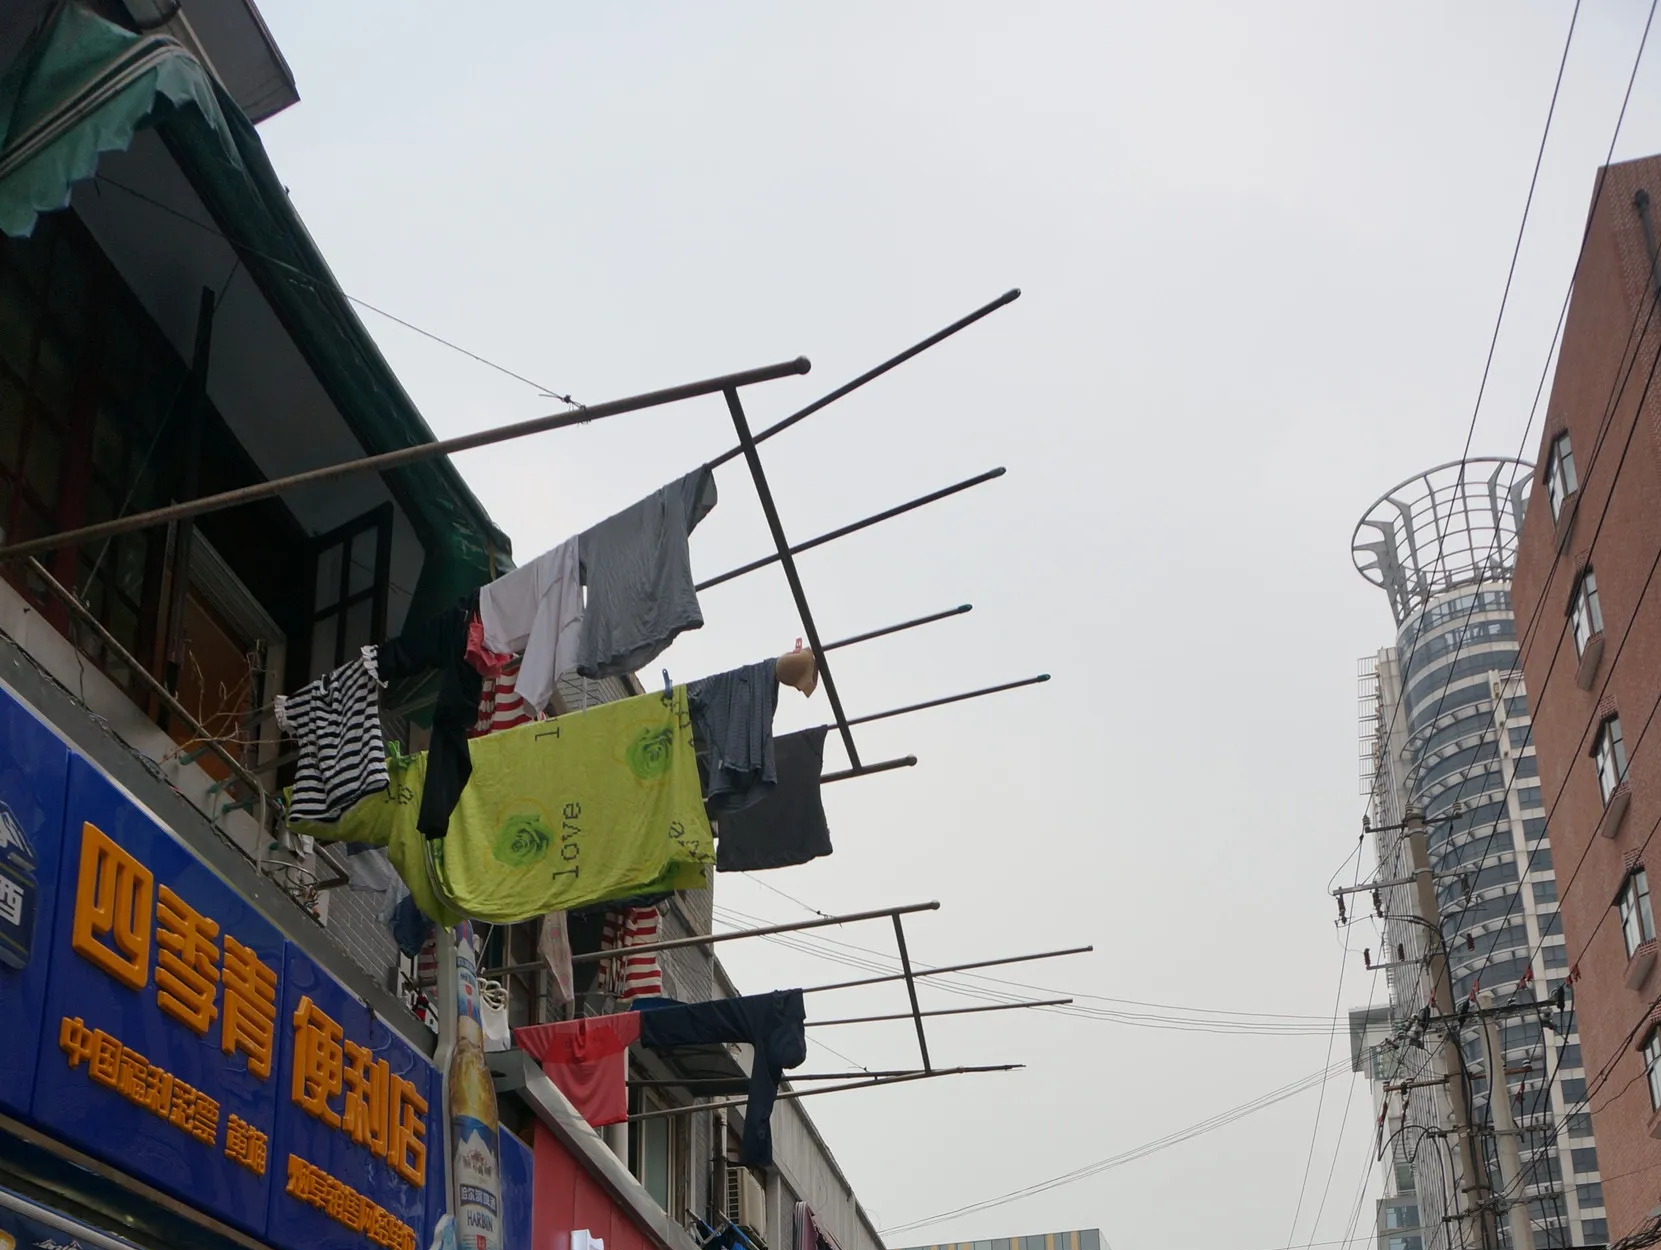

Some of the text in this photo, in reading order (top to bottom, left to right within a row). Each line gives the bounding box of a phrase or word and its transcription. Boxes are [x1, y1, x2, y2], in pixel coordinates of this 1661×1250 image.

[72, 820, 428, 1188] 四季青 便利店
[58, 1016, 221, 1147] 中国福利彩票
[466, 1209, 494, 1233] HARBIN
